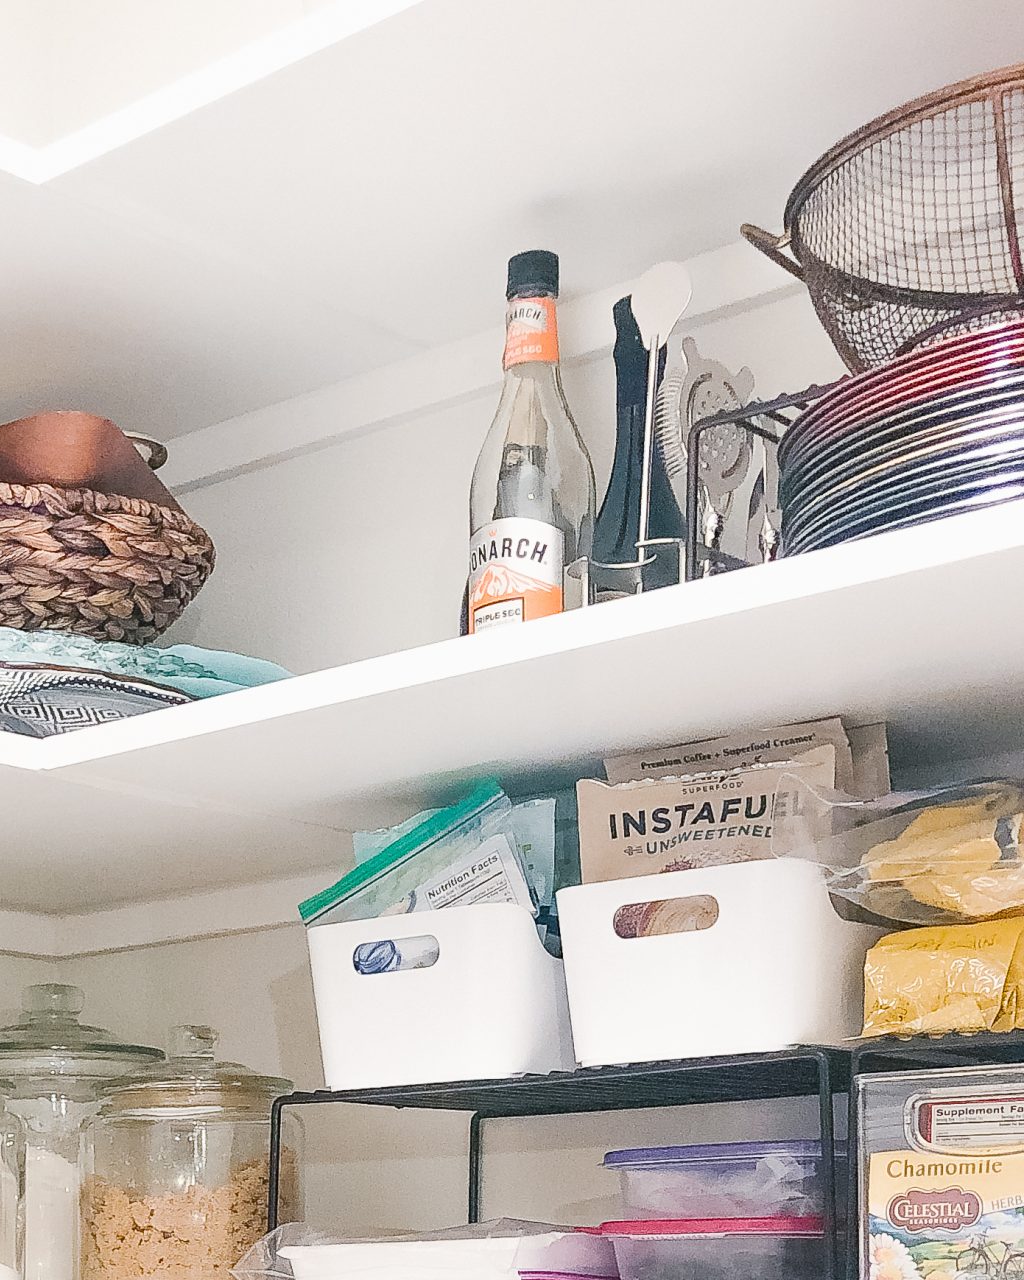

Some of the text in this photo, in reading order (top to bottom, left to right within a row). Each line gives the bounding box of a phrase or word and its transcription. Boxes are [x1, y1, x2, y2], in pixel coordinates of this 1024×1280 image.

[640, 757, 682, 770] Premium
[722, 740, 771, 758] Superfood
[682, 781, 744, 795] SUPERFOOD
[427, 869, 472, 901] Nutrition
[471, 854, 499, 878] Facts
[935, 1105, 1005, 1118] Supplement
[886, 1159, 1003, 1179] Chamomile
[894, 1200, 974, 1220] CELESTIAL
